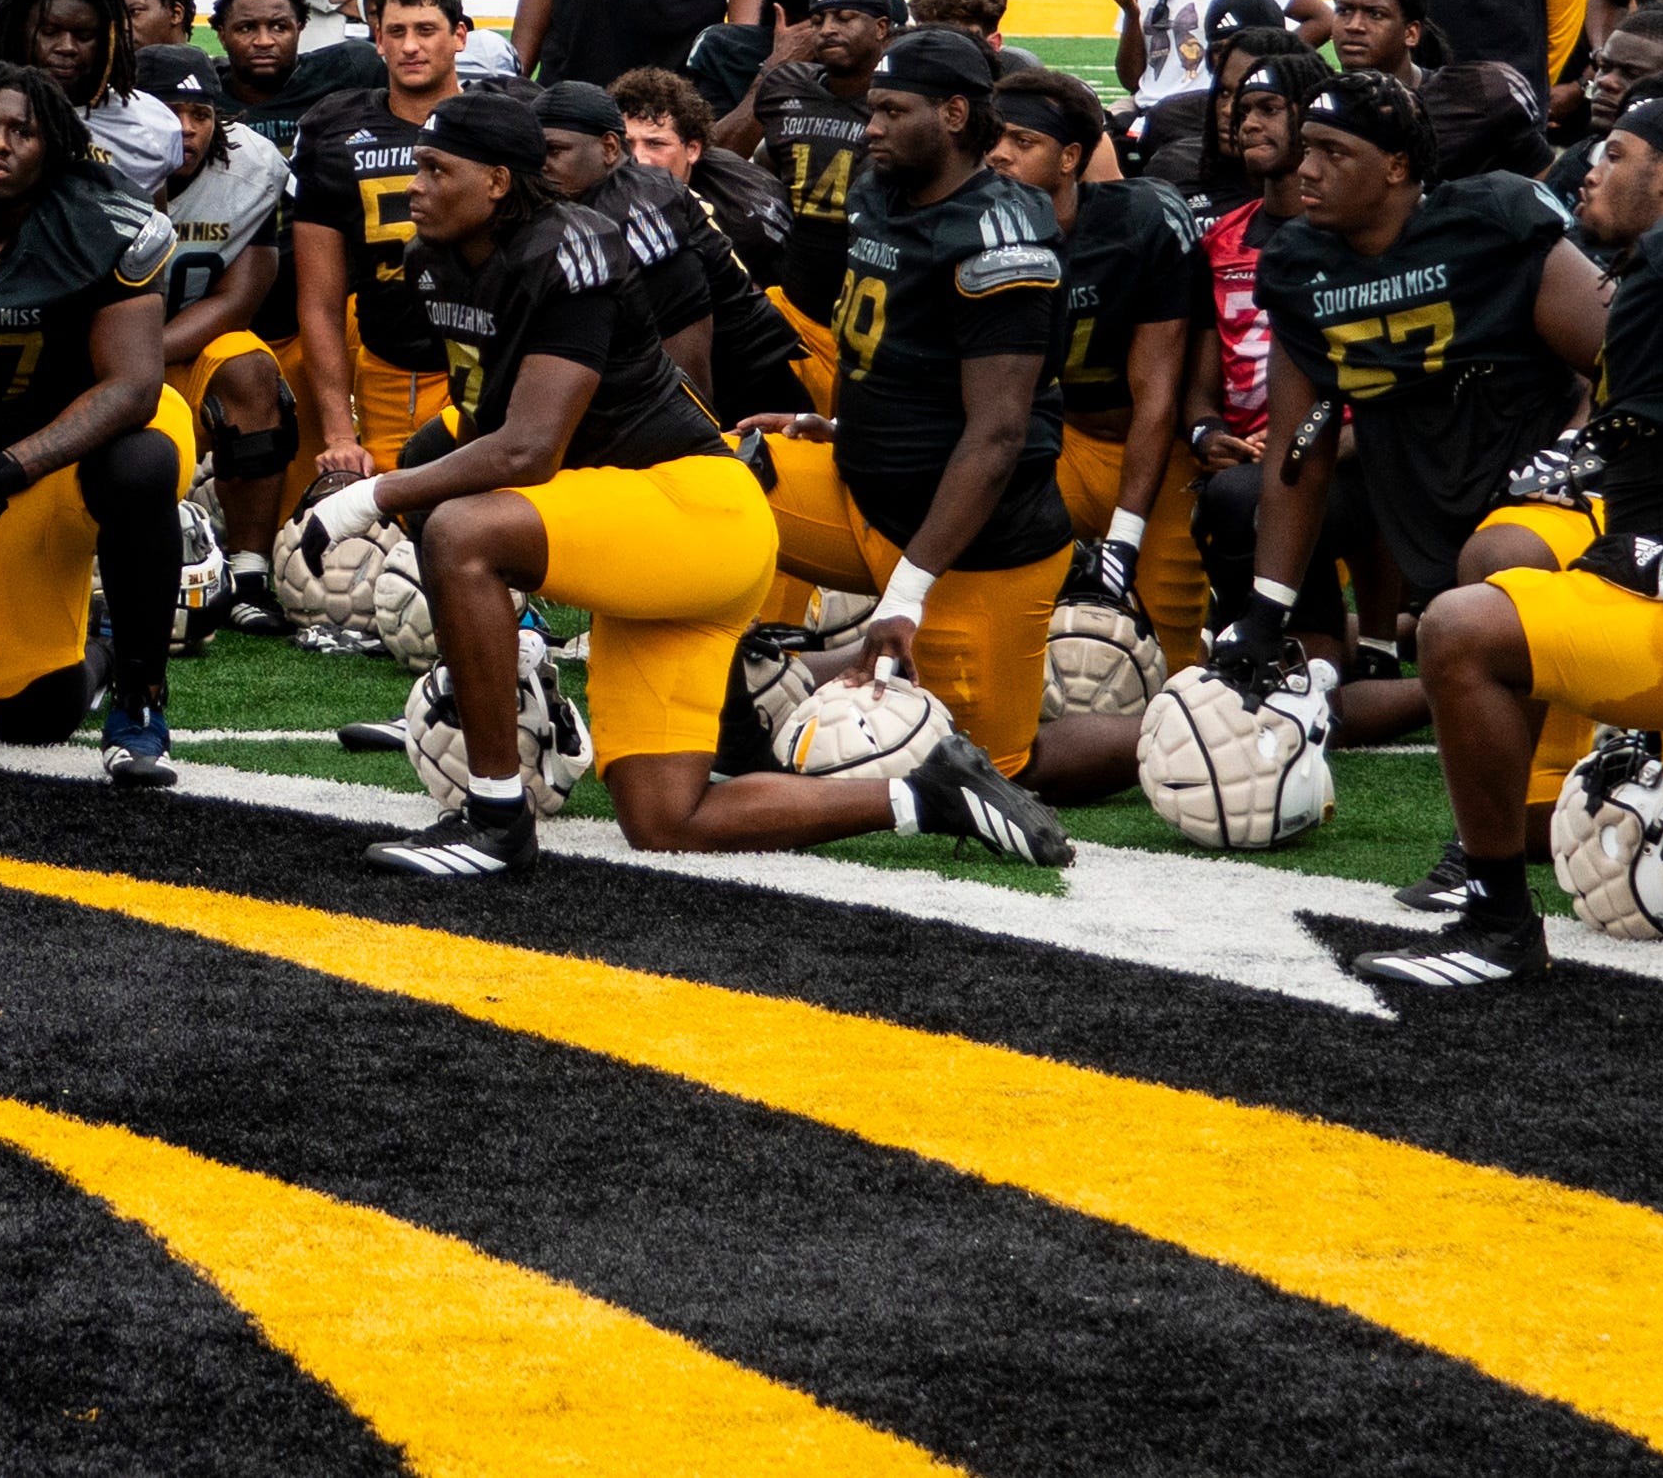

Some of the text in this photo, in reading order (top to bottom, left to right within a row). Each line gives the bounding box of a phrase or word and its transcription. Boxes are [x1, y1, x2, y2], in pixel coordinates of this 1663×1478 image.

[780, 116, 850, 140] SOUTHERN
[353, 146, 419, 172] SOUTH
[789, 143, 854, 224] 14
[192, 222, 229, 242] MISS
[1312, 263, 1448, 319] SOUTHERN MISS
[0, 307, 42, 327] MISS
